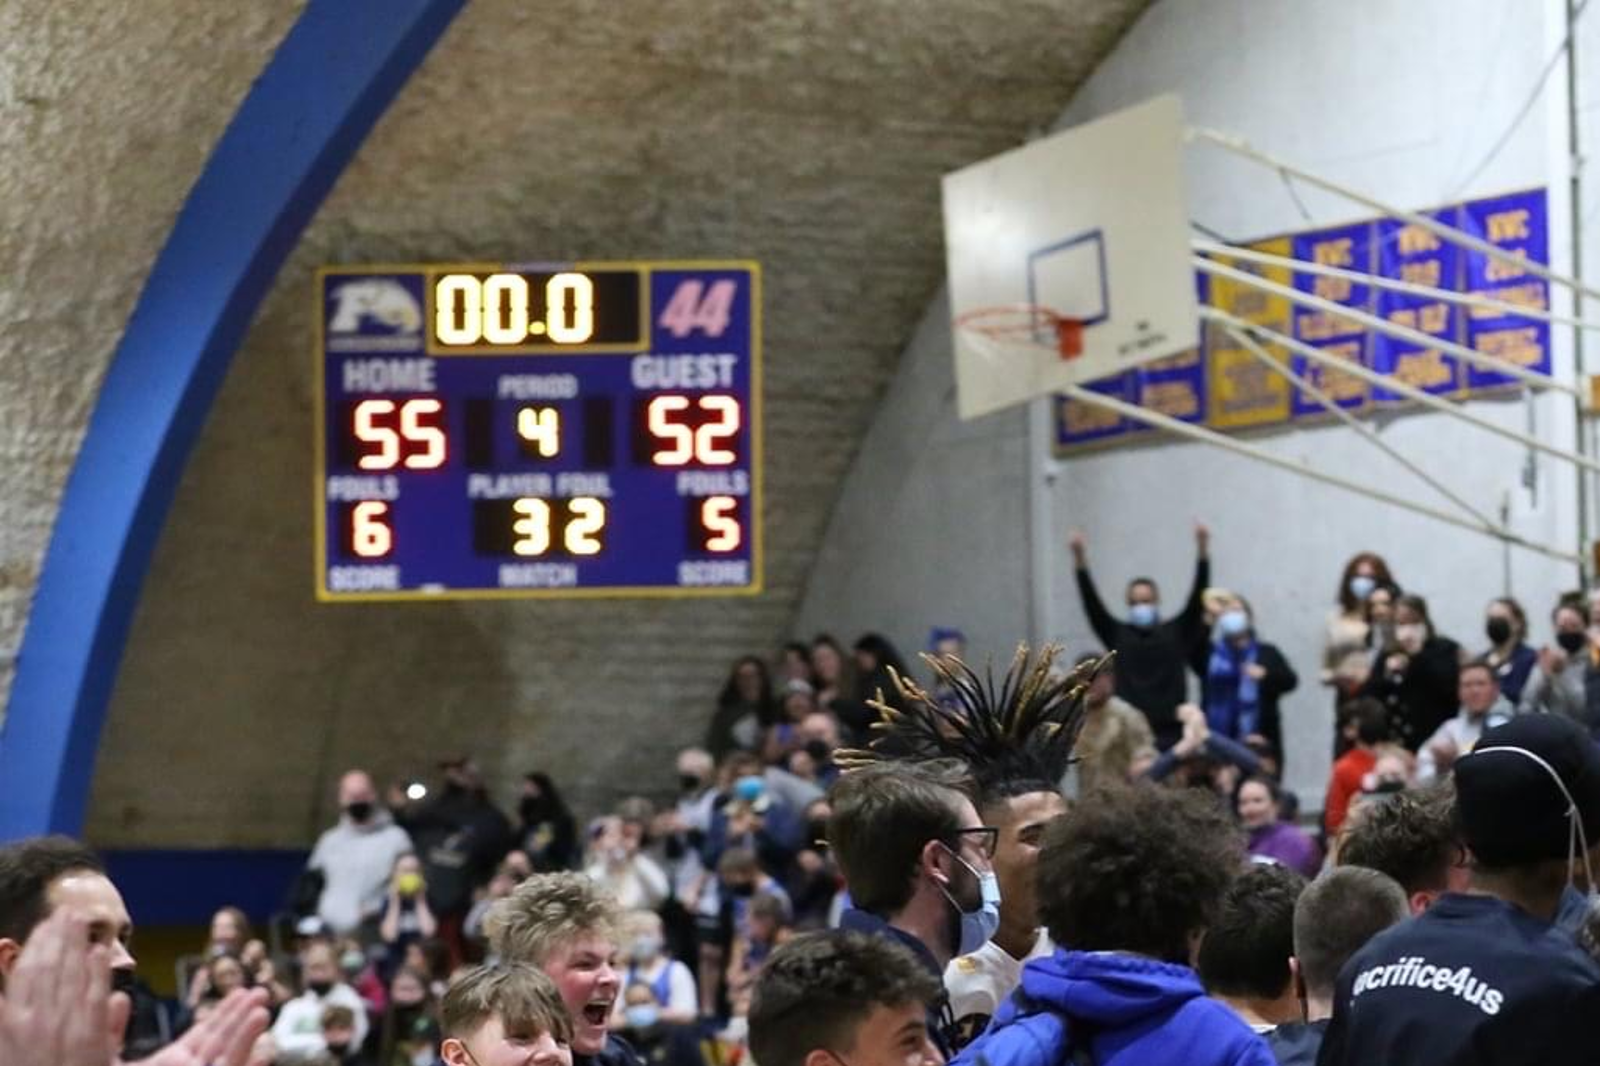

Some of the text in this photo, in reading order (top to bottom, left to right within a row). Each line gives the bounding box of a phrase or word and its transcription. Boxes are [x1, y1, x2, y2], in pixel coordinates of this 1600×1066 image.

[435, 271, 594, 346] 00.0
[342, 358, 437, 393] HOME
[498, 373, 579, 399] PERIOD
[631, 353, 739, 389] GUEST
[352, 397, 447, 471] 55
[516, 406, 561, 458] 4
[646, 395, 742, 467] 52
[327, 474, 399, 502] FOULS
[467, 472, 613, 499] PLAYER FOUL
[676, 469, 748, 496] FOULS
[351, 499, 393, 558] 6
[701, 496, 741, 553] 5
[498, 562, 578, 588] MATCH
[1352, 955, 1505, 1016] acrifice4us
